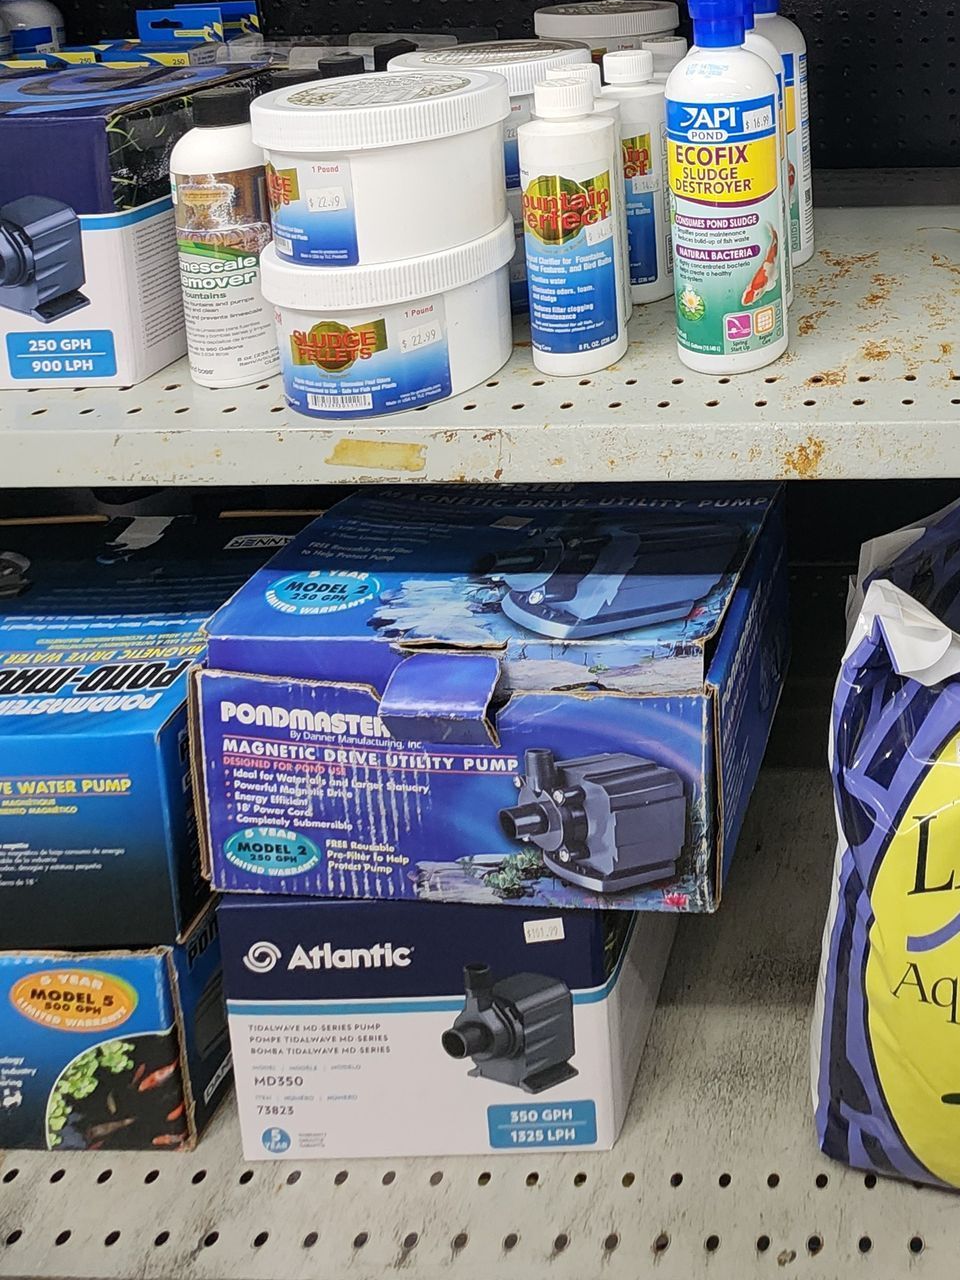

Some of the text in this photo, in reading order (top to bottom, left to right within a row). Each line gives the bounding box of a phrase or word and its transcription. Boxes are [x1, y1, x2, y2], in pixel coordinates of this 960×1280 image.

[693, 107, 736, 128] API
[754, 115, 769, 129] 16.99
[691, 131, 723, 140] POND
[676, 145, 749, 165] ECOFIX
[683, 167, 738, 180] SLUDGE
[676, 179, 751, 194] DESTROYER
[522, 186, 609, 212] ountain
[524, 205, 609, 229] erfect
[679, 248, 752, 260] NATURAL BACTERIA
[411, 305, 434, 316] Pound
[292, 330, 377, 349] SLUDGE
[412, 329, 436, 346] 22.99
[28, 338, 91, 352] 250 GPH
[298, 348, 372, 362] PELLETS
[32, 359, 93, 372] 900 LPH
[290, 730, 404, 750] By Danner Manufacturing,
[222, 739, 518, 772] MAGNETIC DRIVE UTILITY PUMP
[17, 779, 131, 794] WATER PUMP
[236, 842, 307, 856] MODEL 2
[250, 854, 298, 864] 250 GPH
[288, 942, 412, 971] Atlantic
[31, 989, 114, 1006] MODEL 5
[44, 1002, 101, 1015] 500 GPH
[249, 1024, 300, 1032] TIDALWAVE
[254, 1076, 304, 1086] MD350
[257, 1105, 294, 1115] 73823
[510, 1109, 573, 1122] 350 GPH
[510, 1128, 575, 1142] 1325 LPH
